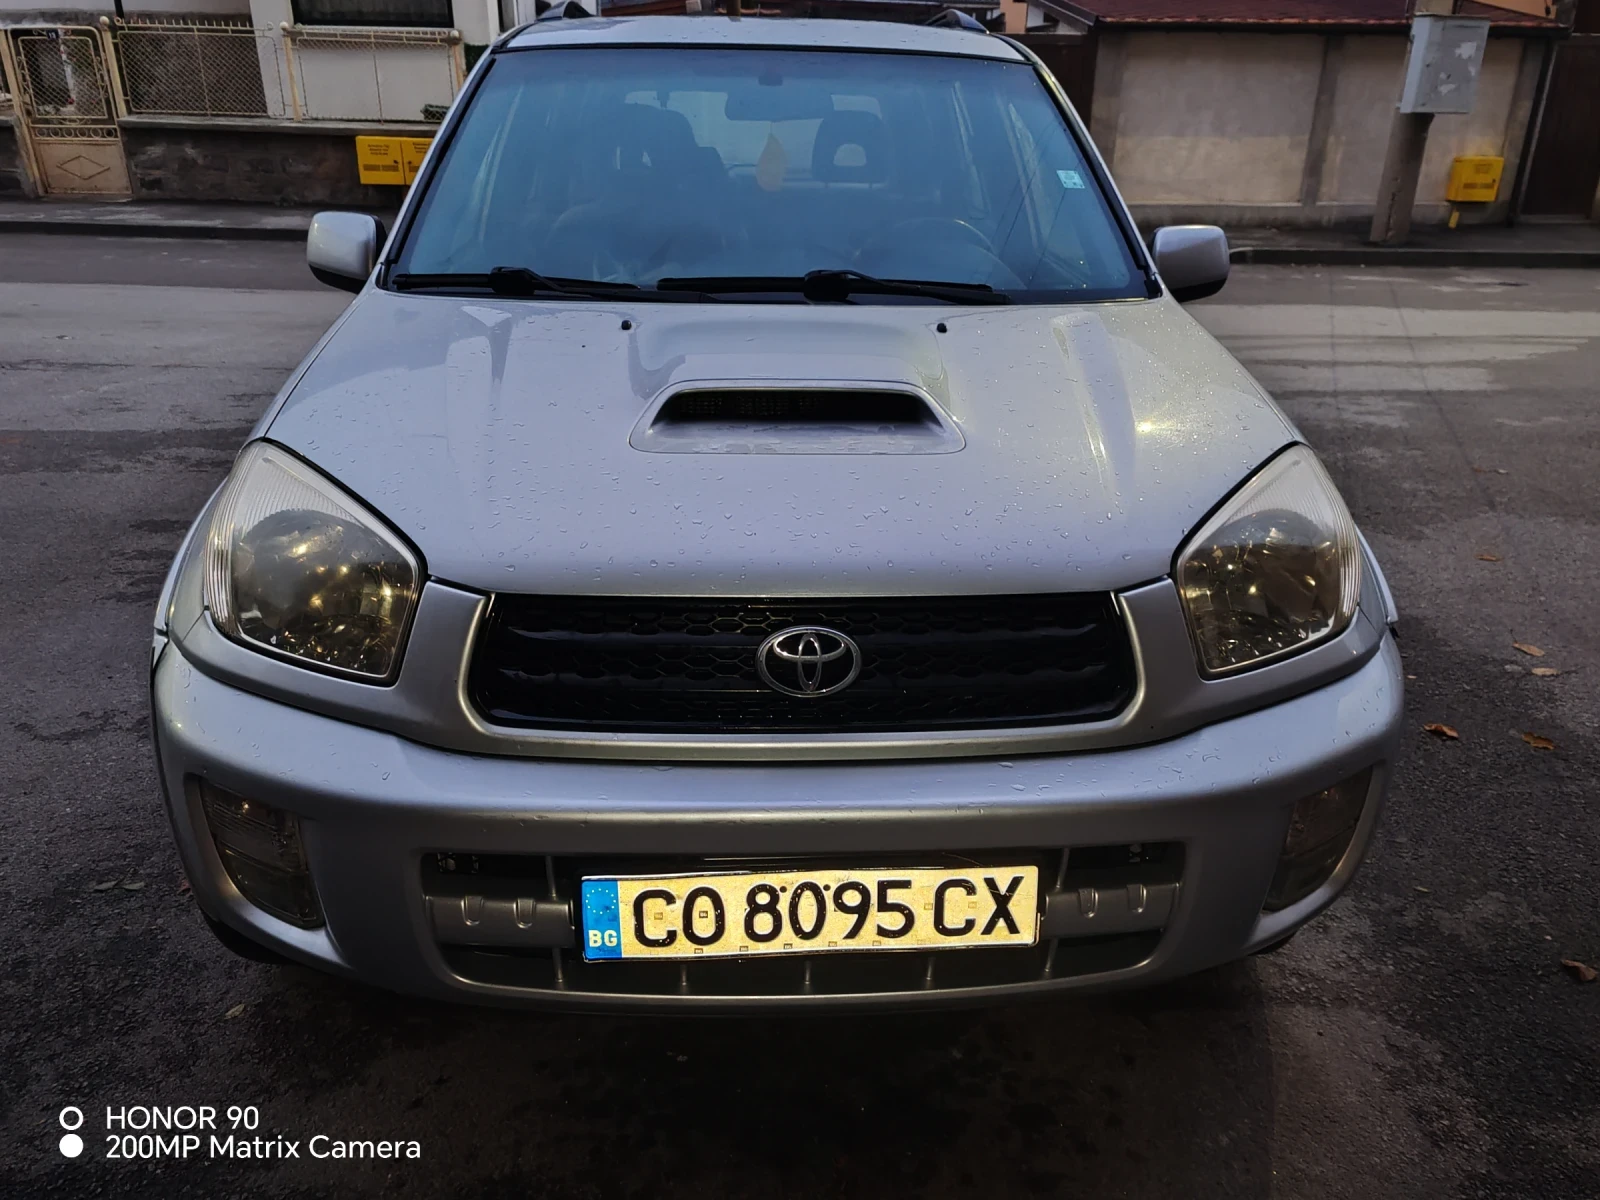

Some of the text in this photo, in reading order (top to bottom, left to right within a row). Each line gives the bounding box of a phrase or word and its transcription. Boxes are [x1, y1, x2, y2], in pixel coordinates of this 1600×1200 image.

[633, 876, 1025, 948] CO 8095 CX
[588, 929, 618, 948] BG
